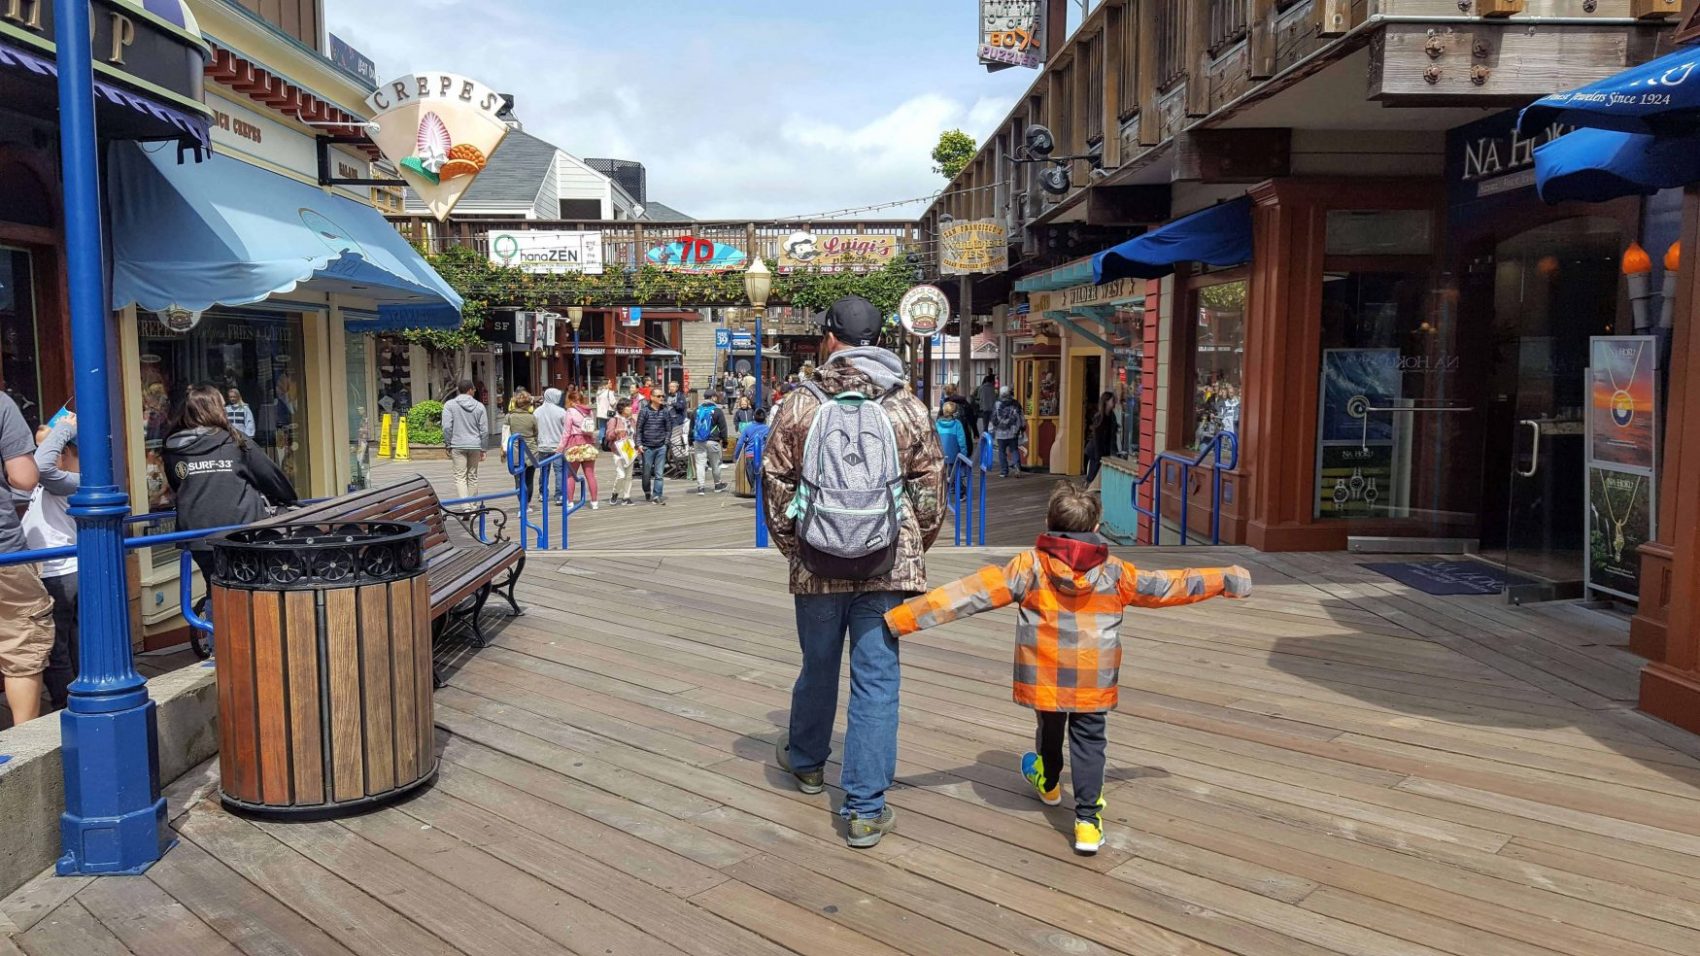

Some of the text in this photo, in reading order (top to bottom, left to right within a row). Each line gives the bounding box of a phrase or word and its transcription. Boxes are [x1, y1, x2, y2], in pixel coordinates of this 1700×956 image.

[991, 27, 1041, 51] BOX
[982, 46, 1038, 68] PUZZLES
[374, 76, 498, 110] CREPES
[1605, 92, 1636, 107] Since
[1638, 93, 1671, 105] 1924
[233, 118, 262, 144] CREPES
[1462, 137, 1503, 180] NA
[944, 228, 957, 238] SAN
[676, 235, 715, 265] 7D
[823, 236, 890, 256] Luigi's
[1070, 284, 1097, 304] WILDER
[1101, 279, 1124, 299] WEST
[494, 321, 510, 331] SF
[717, 336, 728, 345] 39
[188, 460, 232, 471] SURF-33
